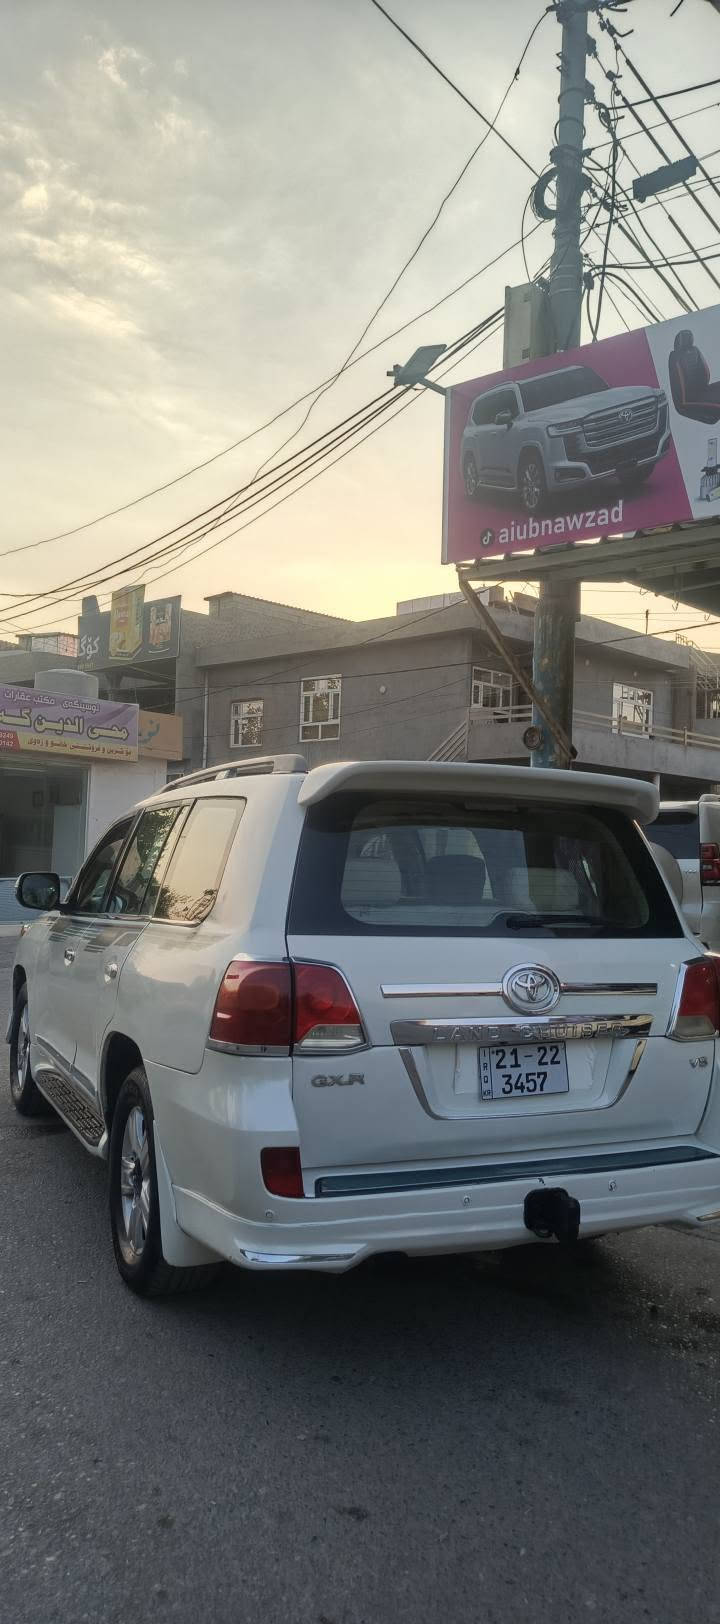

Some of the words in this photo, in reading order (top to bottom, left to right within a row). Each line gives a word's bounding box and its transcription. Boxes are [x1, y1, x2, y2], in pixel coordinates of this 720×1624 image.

[498, 499, 624, 545] aiubnawzad
[432, 1025, 500, 1041] LAND
[495, 1045, 561, 1069] 21-22
[501, 1071, 548, 1095] 3457
